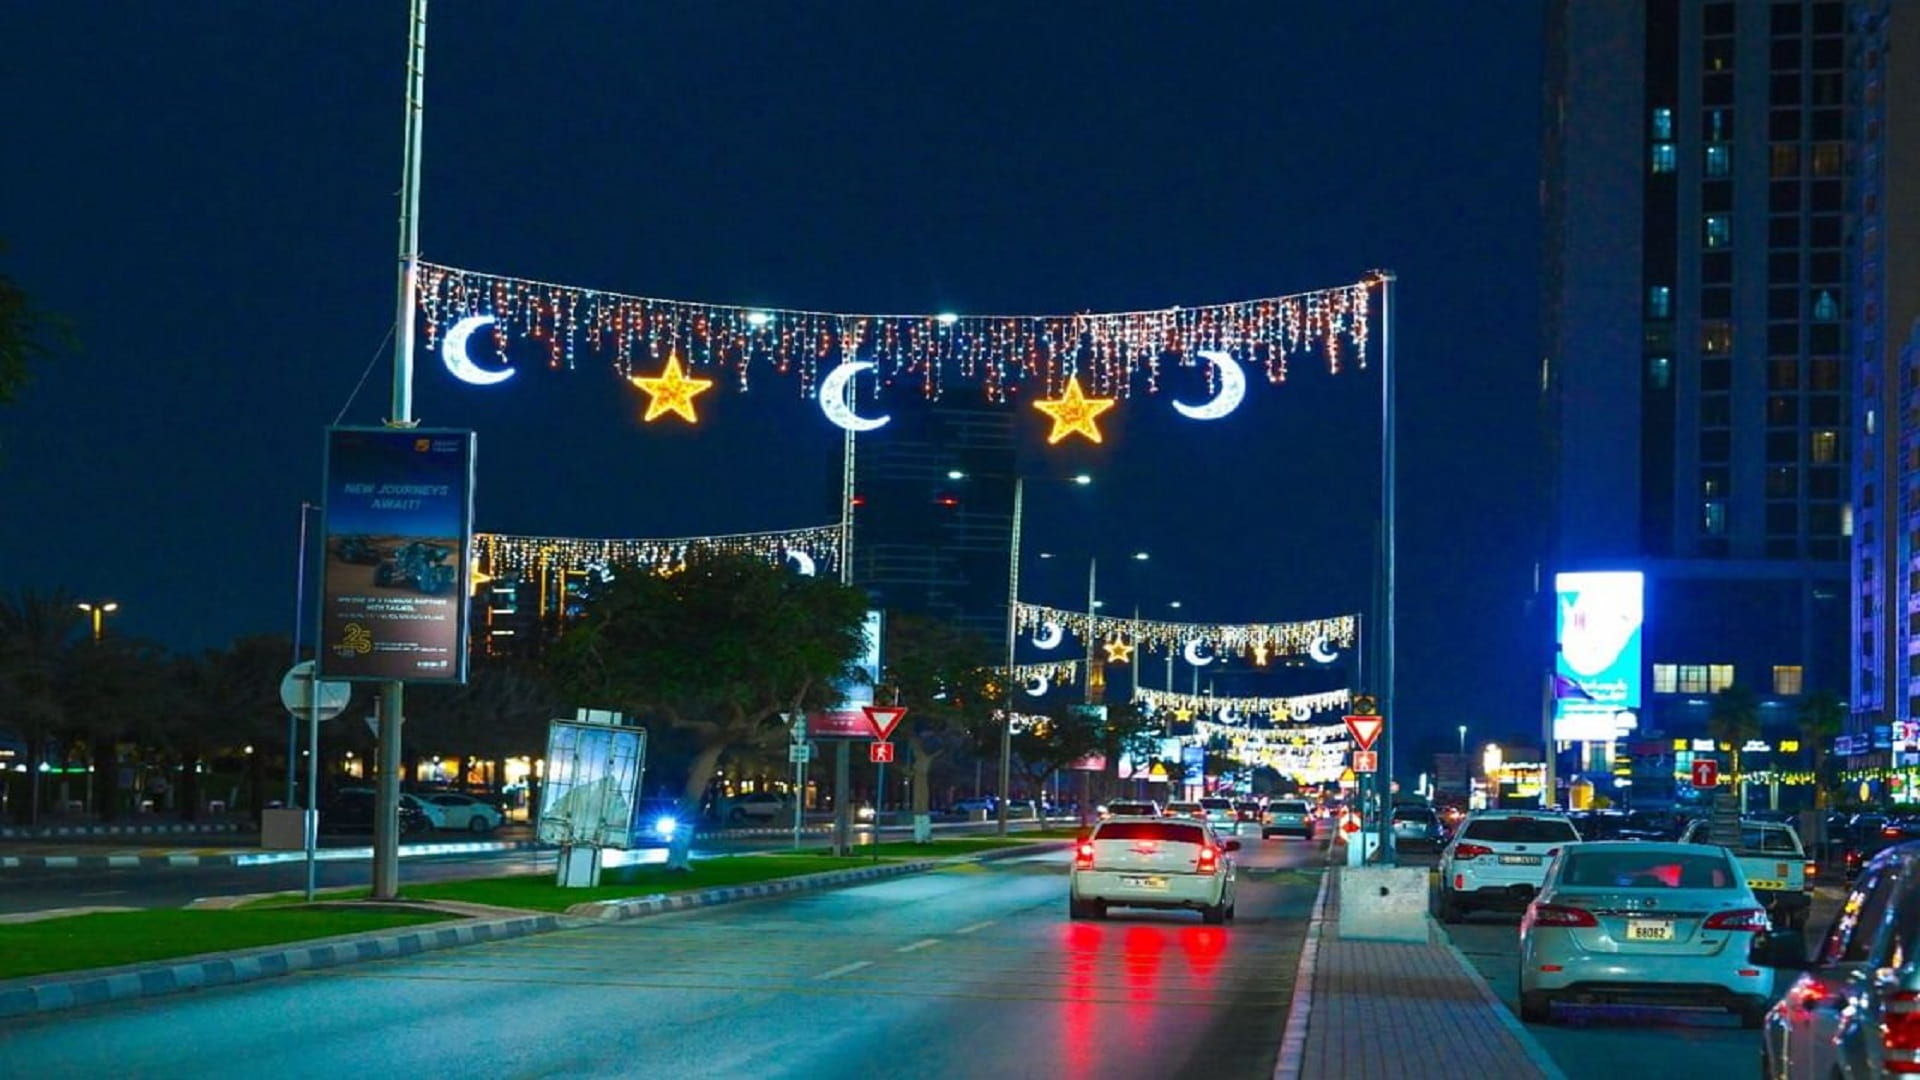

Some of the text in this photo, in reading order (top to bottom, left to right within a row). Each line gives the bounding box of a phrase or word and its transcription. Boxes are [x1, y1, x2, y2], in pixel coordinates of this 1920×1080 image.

[344, 483, 449, 497] NEW JOURNEYS
[342, 622, 372, 654] 25
